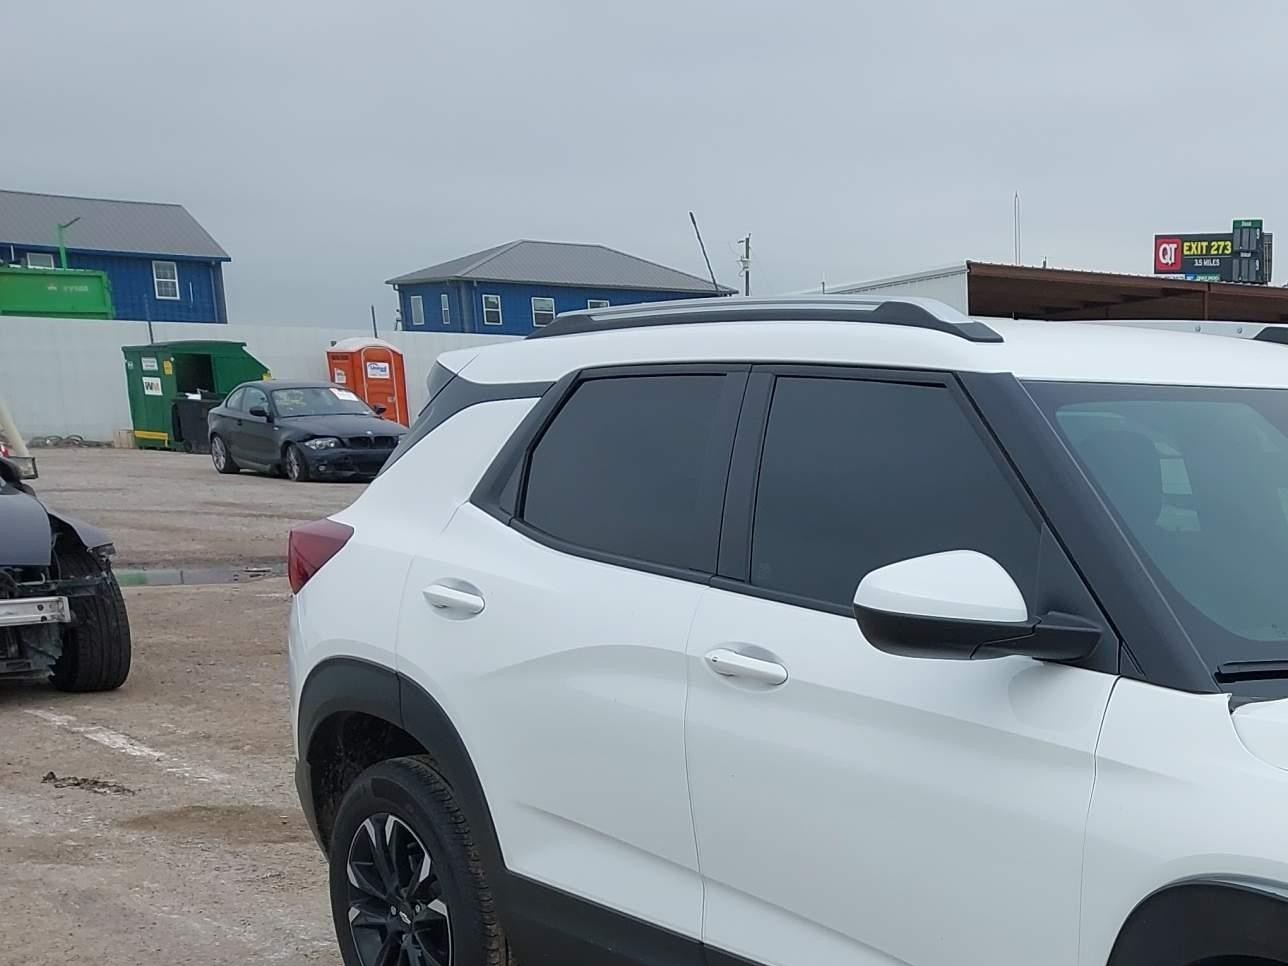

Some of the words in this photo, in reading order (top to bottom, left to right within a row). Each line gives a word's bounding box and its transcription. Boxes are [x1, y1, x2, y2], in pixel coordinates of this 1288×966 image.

[1159, 243, 1178, 265] QT
[1183, 241, 1209, 255] EXIT
[1210, 240, 1232, 255] 273
[1203, 258, 1220, 267] MILES
